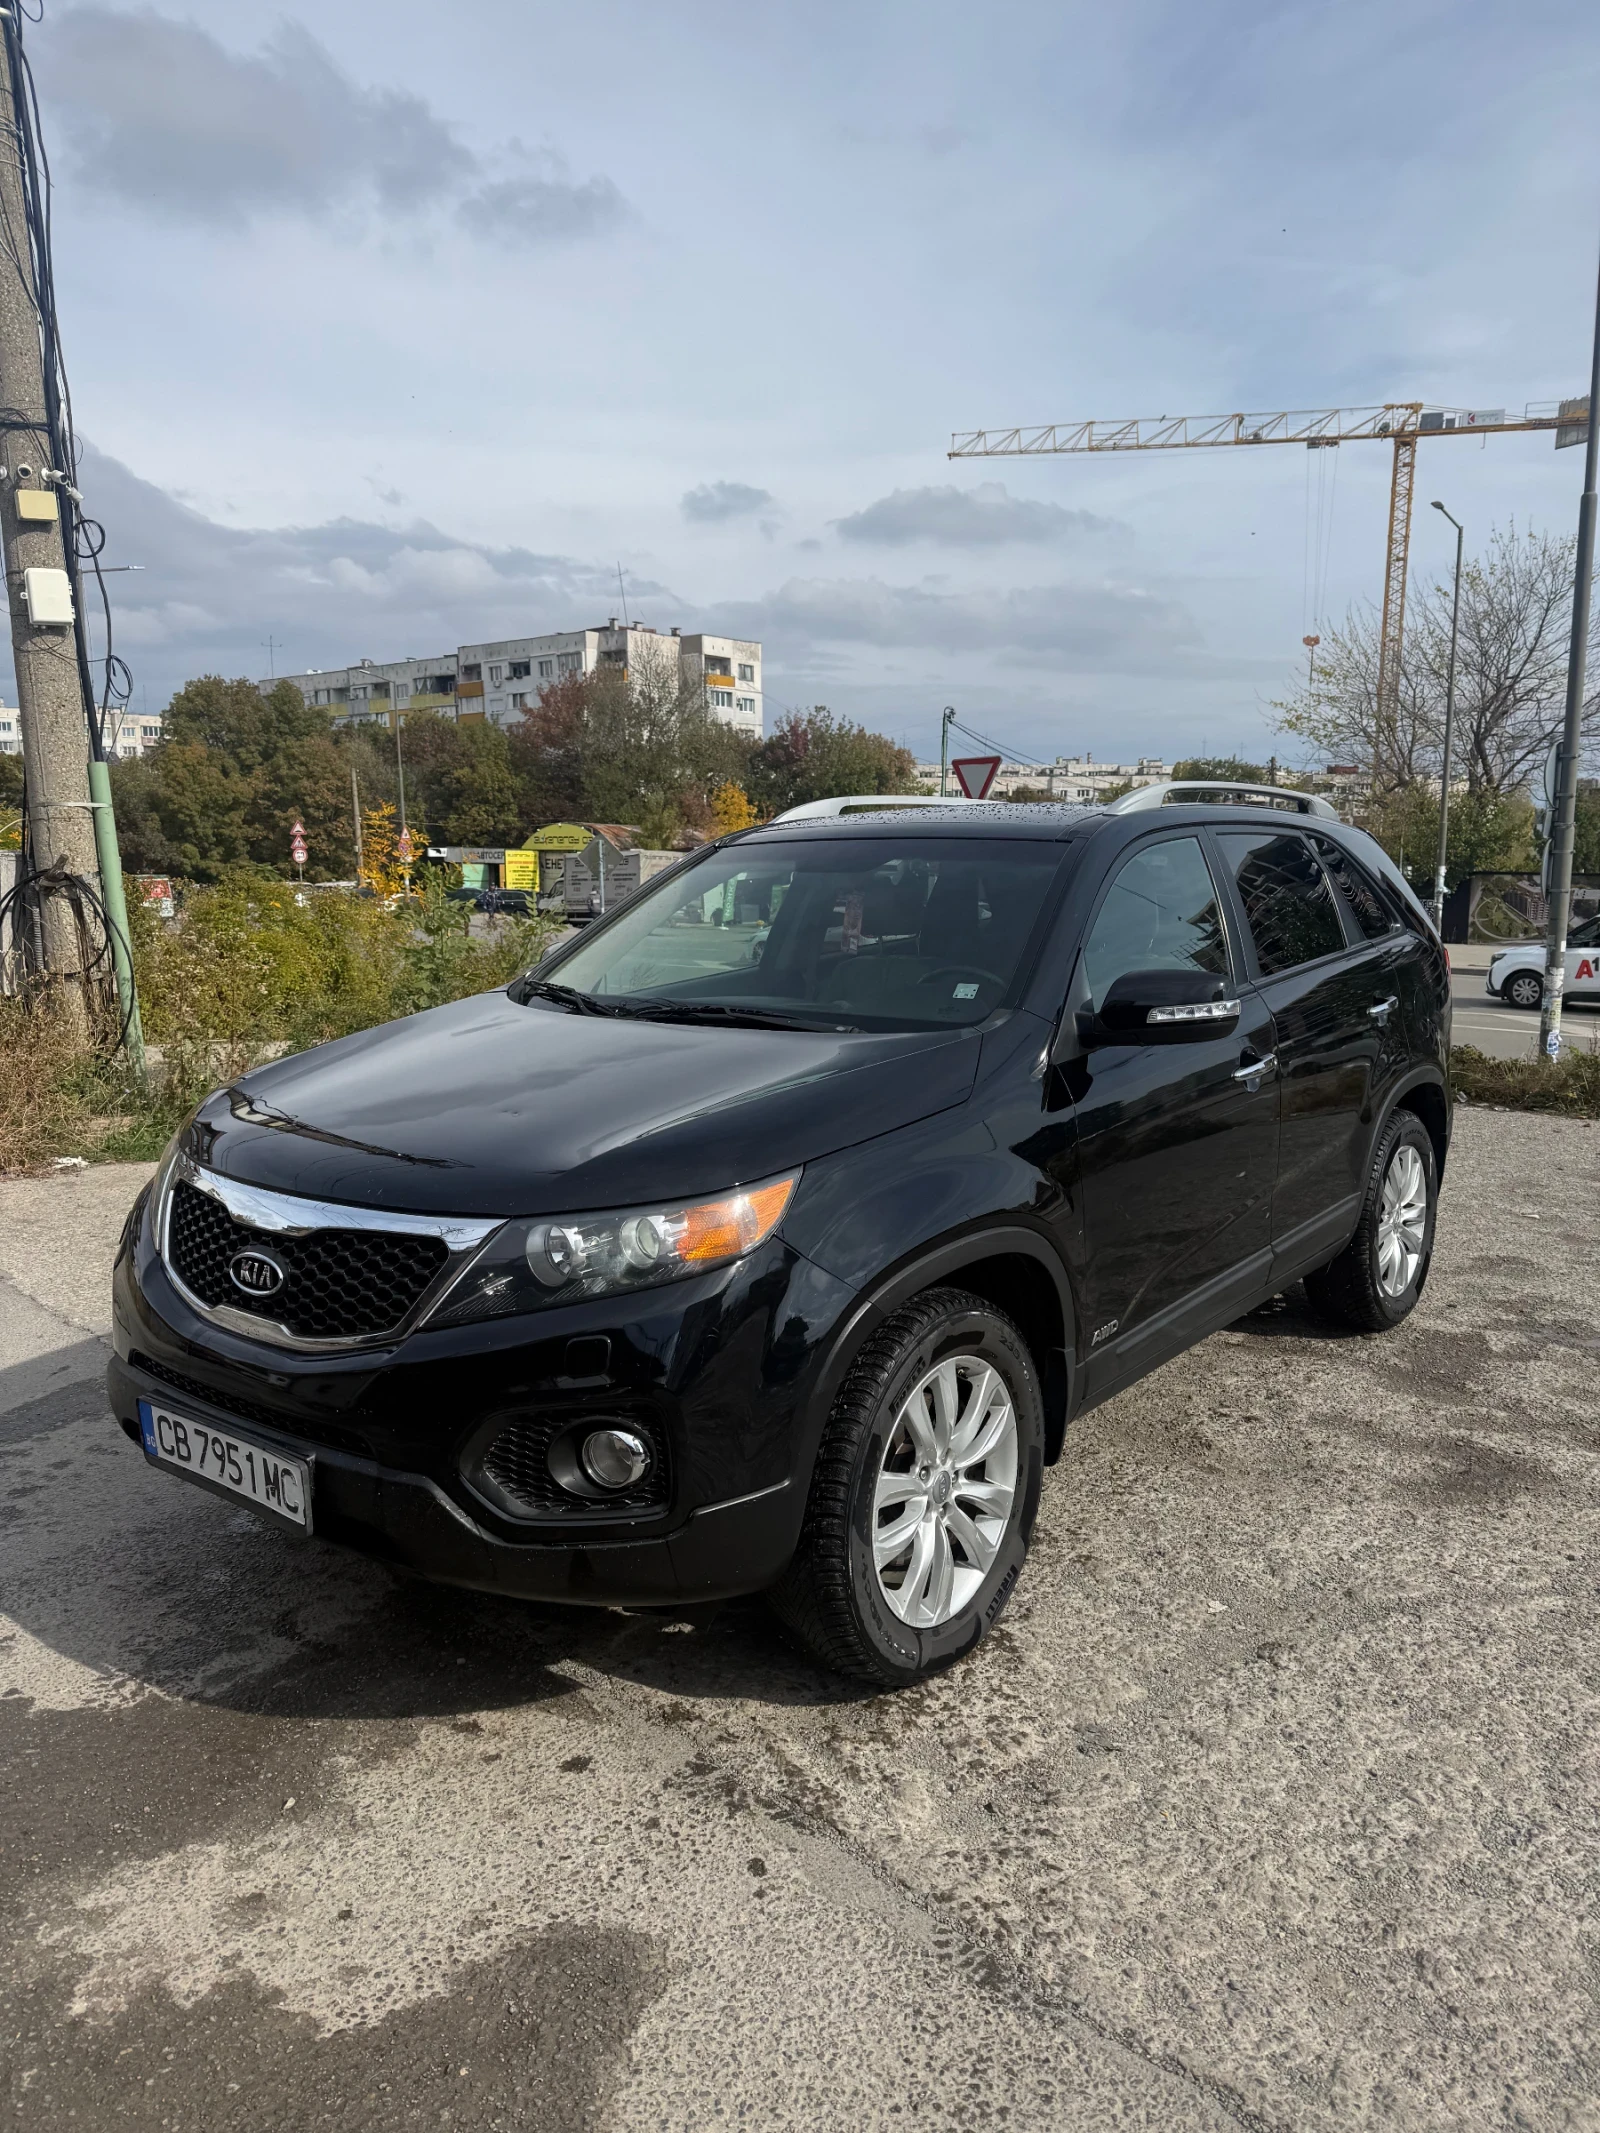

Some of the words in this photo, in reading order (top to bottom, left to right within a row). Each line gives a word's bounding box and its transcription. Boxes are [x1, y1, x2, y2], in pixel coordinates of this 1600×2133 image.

[239, 1258, 272, 1289] KIA
[1091, 1319, 1119, 1347] AWD
[145, 1433, 157, 1449] BG
[984, 1564, 1019, 1624] PIRELLI
